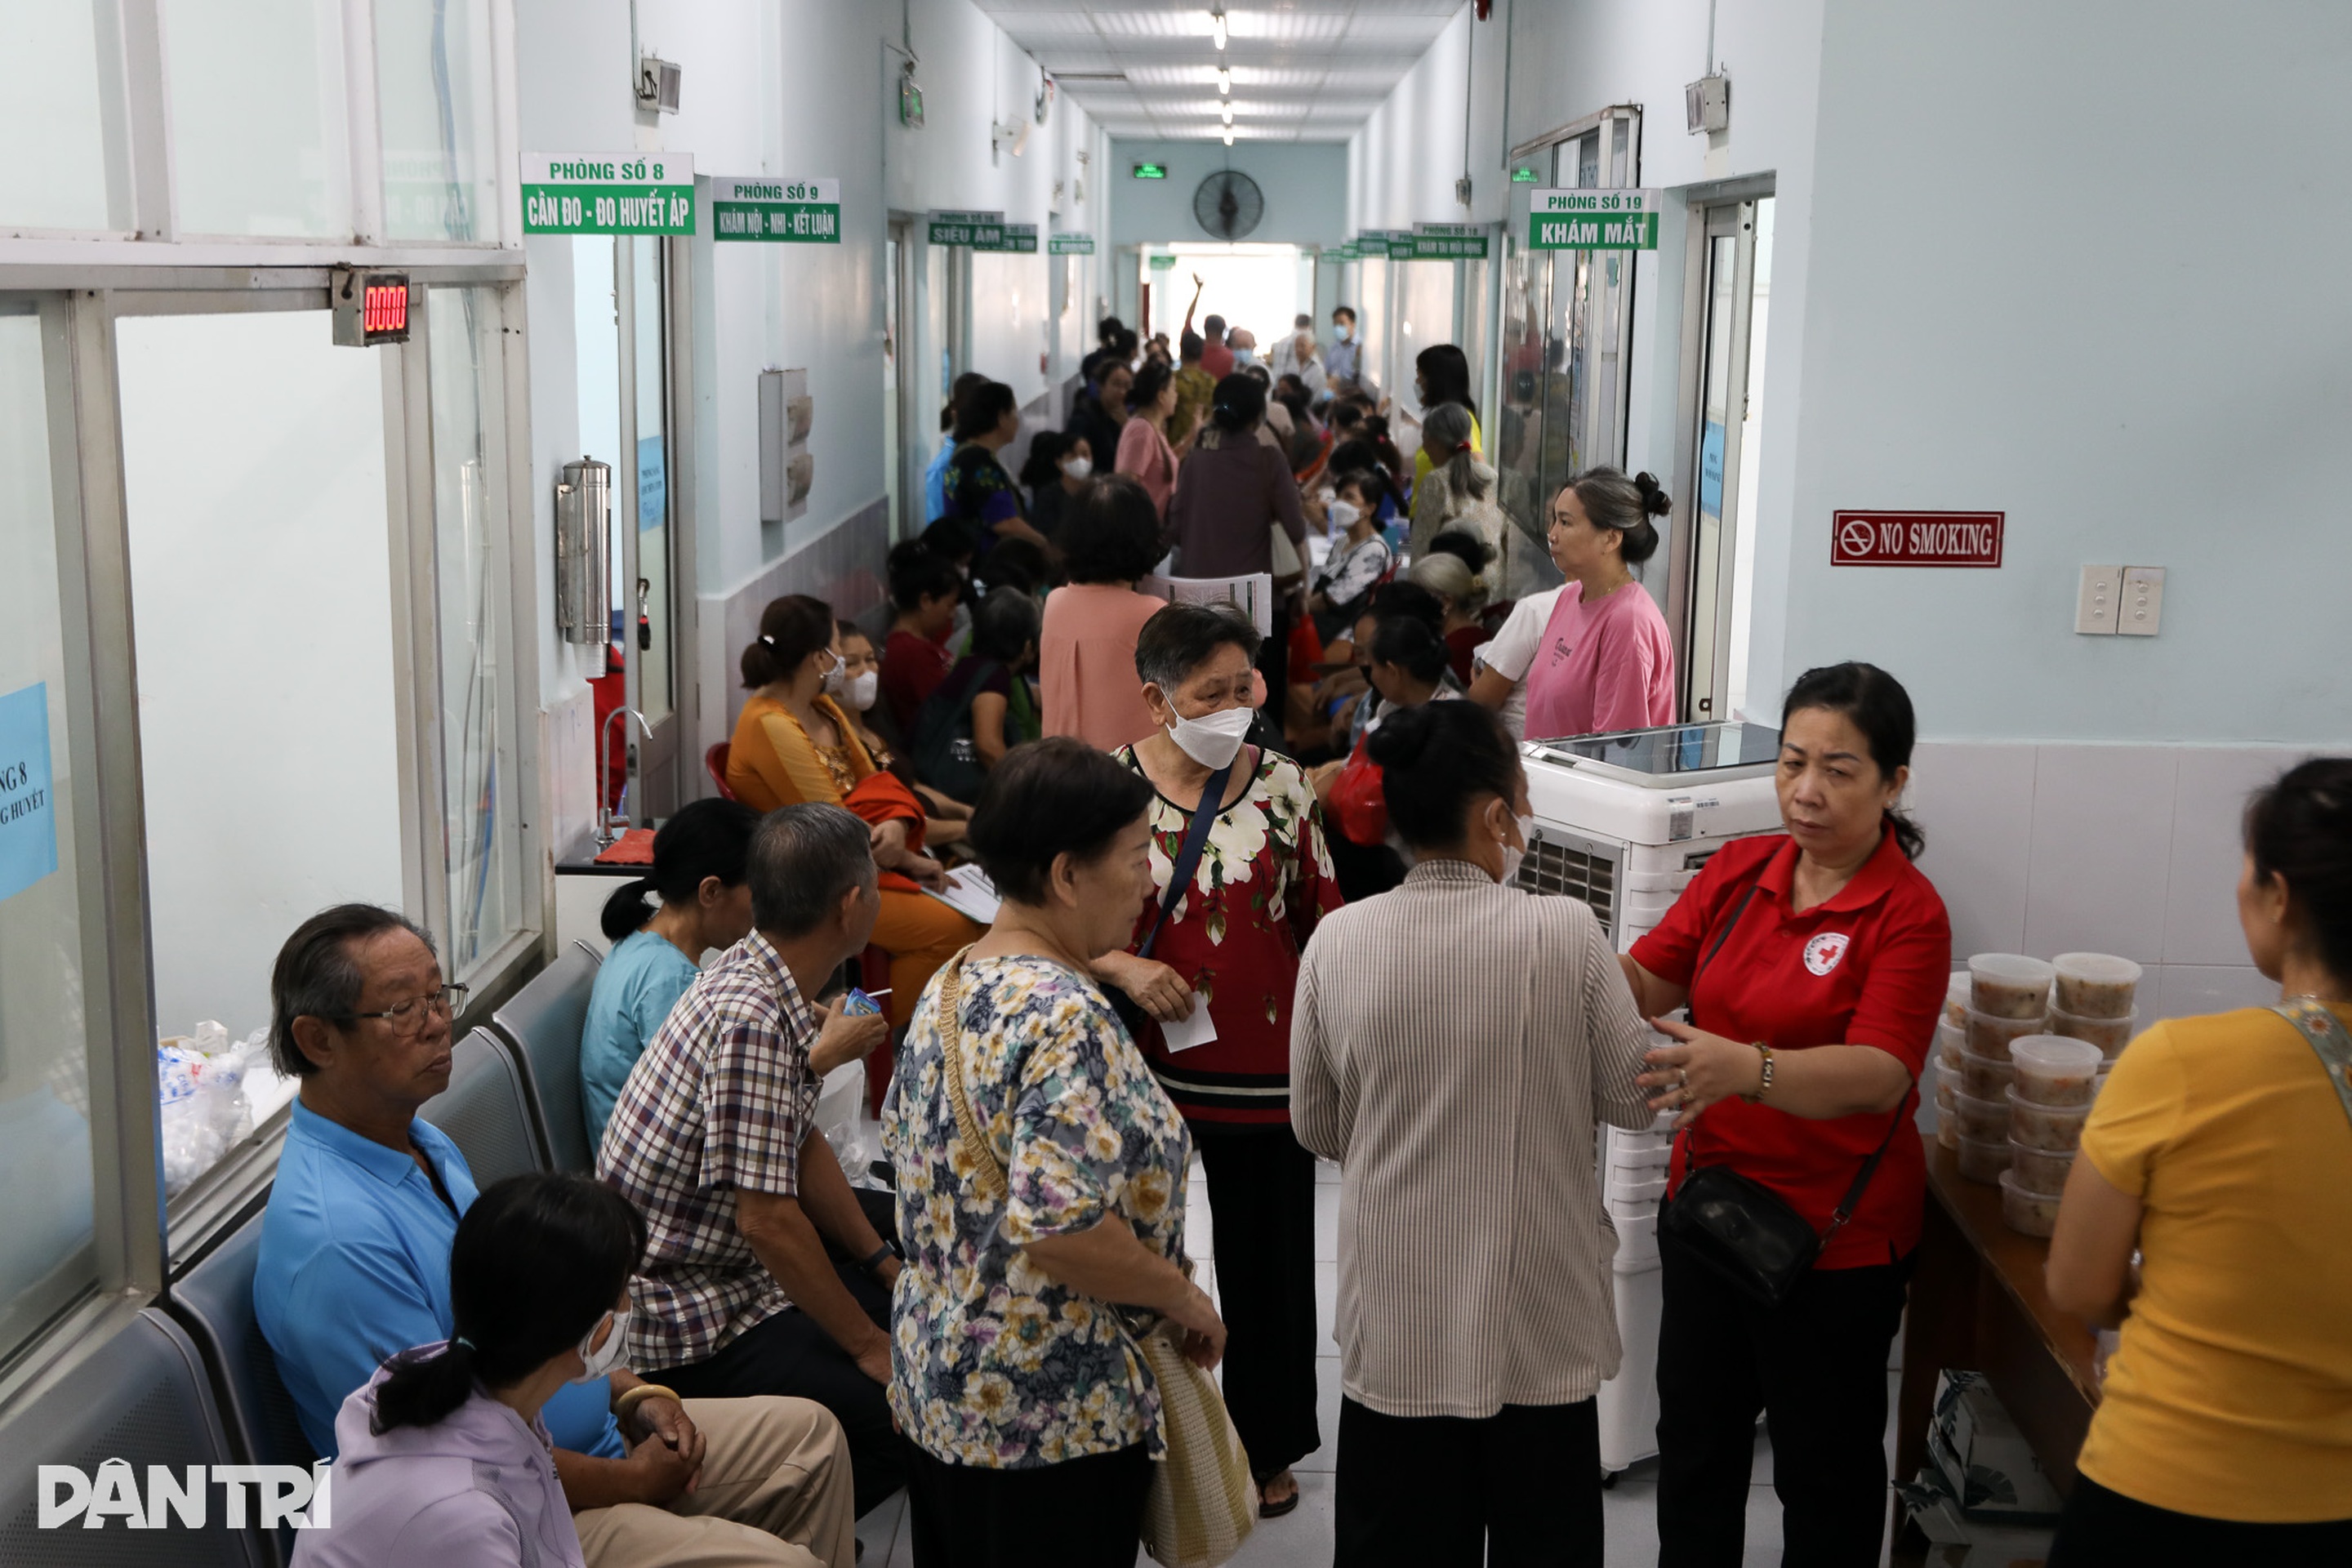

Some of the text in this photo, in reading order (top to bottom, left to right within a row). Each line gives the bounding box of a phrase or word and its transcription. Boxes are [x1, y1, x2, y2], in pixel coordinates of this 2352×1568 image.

[550, 157, 664, 180] PHÒNG SỐ 8
[734, 181, 818, 199] PHÒNG SỐ 9
[1548, 192, 1642, 209] PHÒNG SỐ 19
[562, 197, 582, 226] ĐO
[595, 197, 617, 226] ĐO
[620, 188, 666, 227] HUYẾT
[670, 191, 689, 226] ÁP
[719, 207, 746, 234] KHÁM
[747, 207, 764, 238] NỘI
[770, 212, 786, 234] NHI
[794, 207, 809, 235] KẾT
[812, 209, 835, 239] LUẬN
[933, 225, 970, 243] SIÊU
[974, 226, 1000, 243] ÂM
[1541, 216, 1646, 243] KHÁM MẮT
[1878, 523, 1993, 555] NO SMOKING
[19, 761, 28, 785] 8
